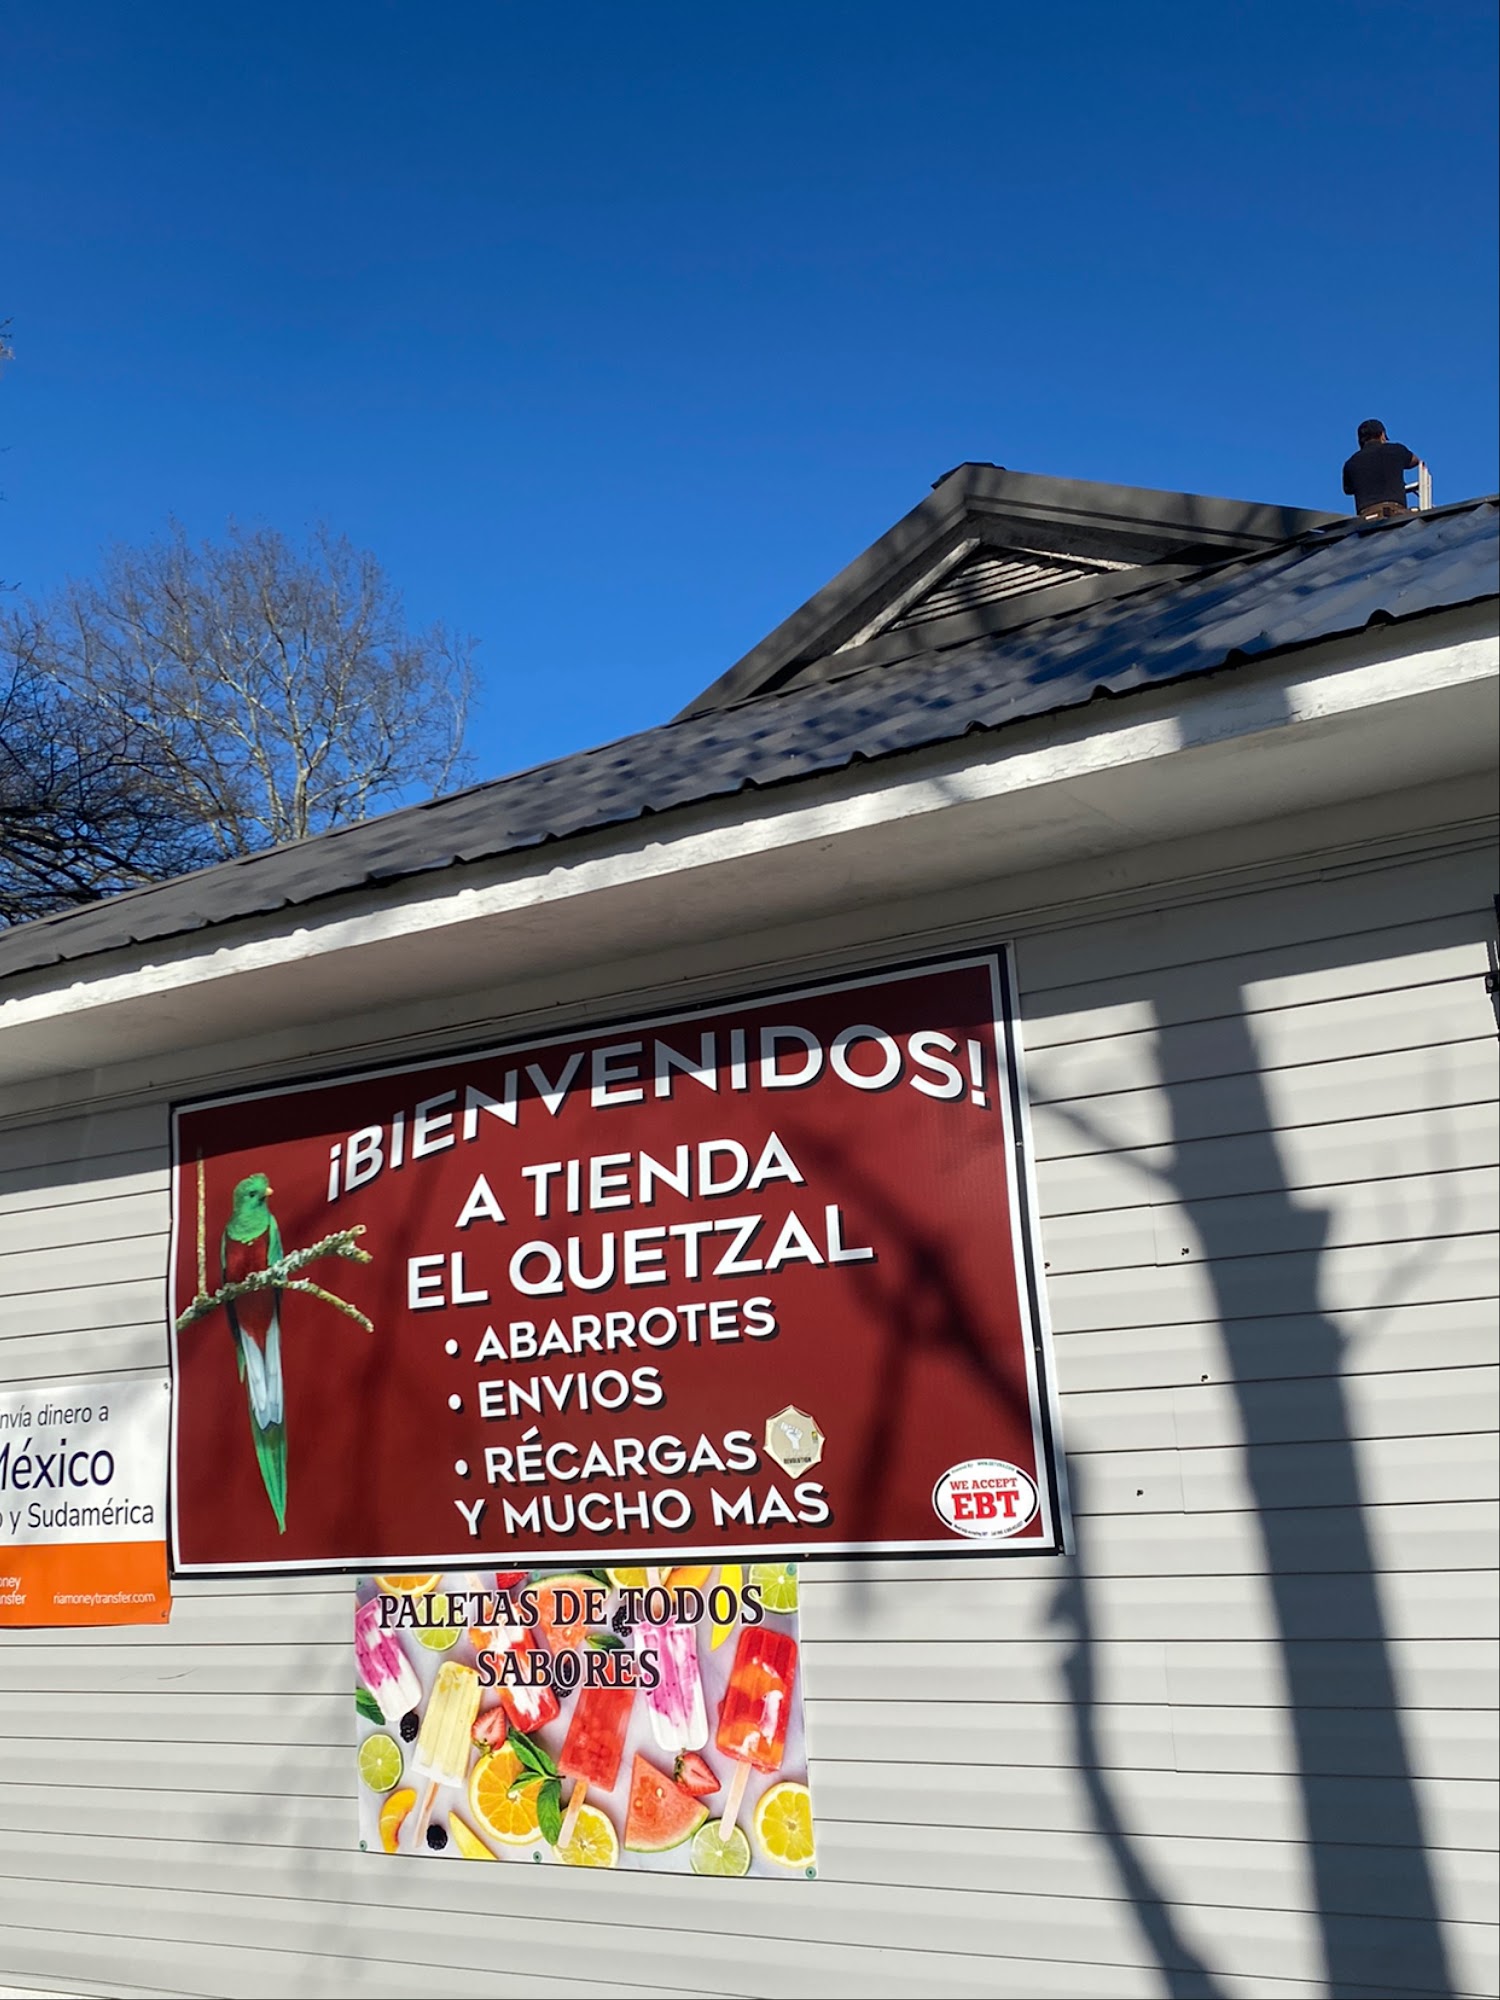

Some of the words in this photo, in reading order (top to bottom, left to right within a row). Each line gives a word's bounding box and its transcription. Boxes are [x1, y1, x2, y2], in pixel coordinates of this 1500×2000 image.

[327, 1024, 988, 1203] ¡BIENVENIDOS!
[456, 1174, 506, 1229] A
[522, 1131, 804, 1217] TIENDA
[408, 1251, 489, 1309] EL
[509, 1204, 874, 1295] QUETZAL
[474, 1297, 776, 1363] ABARROTES
[37, 1404, 92, 1426] dinero
[98, 1405, 109, 1421] a
[478, 1366, 664, 1418] ENVIOS
[484, 1426, 758, 1484] RÉCARGAS
[950, 1480, 969, 1490] WE
[972, 1477, 1018, 1489] ACCEPT
[951, 1490, 1020, 1520] EBT
[9, 1510, 21, 1535] y
[27, 1498, 154, 1528] Sudamérica
[454, 1498, 486, 1535] Y
[502, 1488, 692, 1534] MUCHO
[711, 1482, 830, 1526] MAS
[53, 1591, 155, 1606] riamoneytransfer.com
[378, 1587, 540, 1628] PALETAS
[552, 1587, 608, 1627] DE
[619, 1585, 765, 1628] TODOS
[477, 1648, 661, 1689] SABORES
